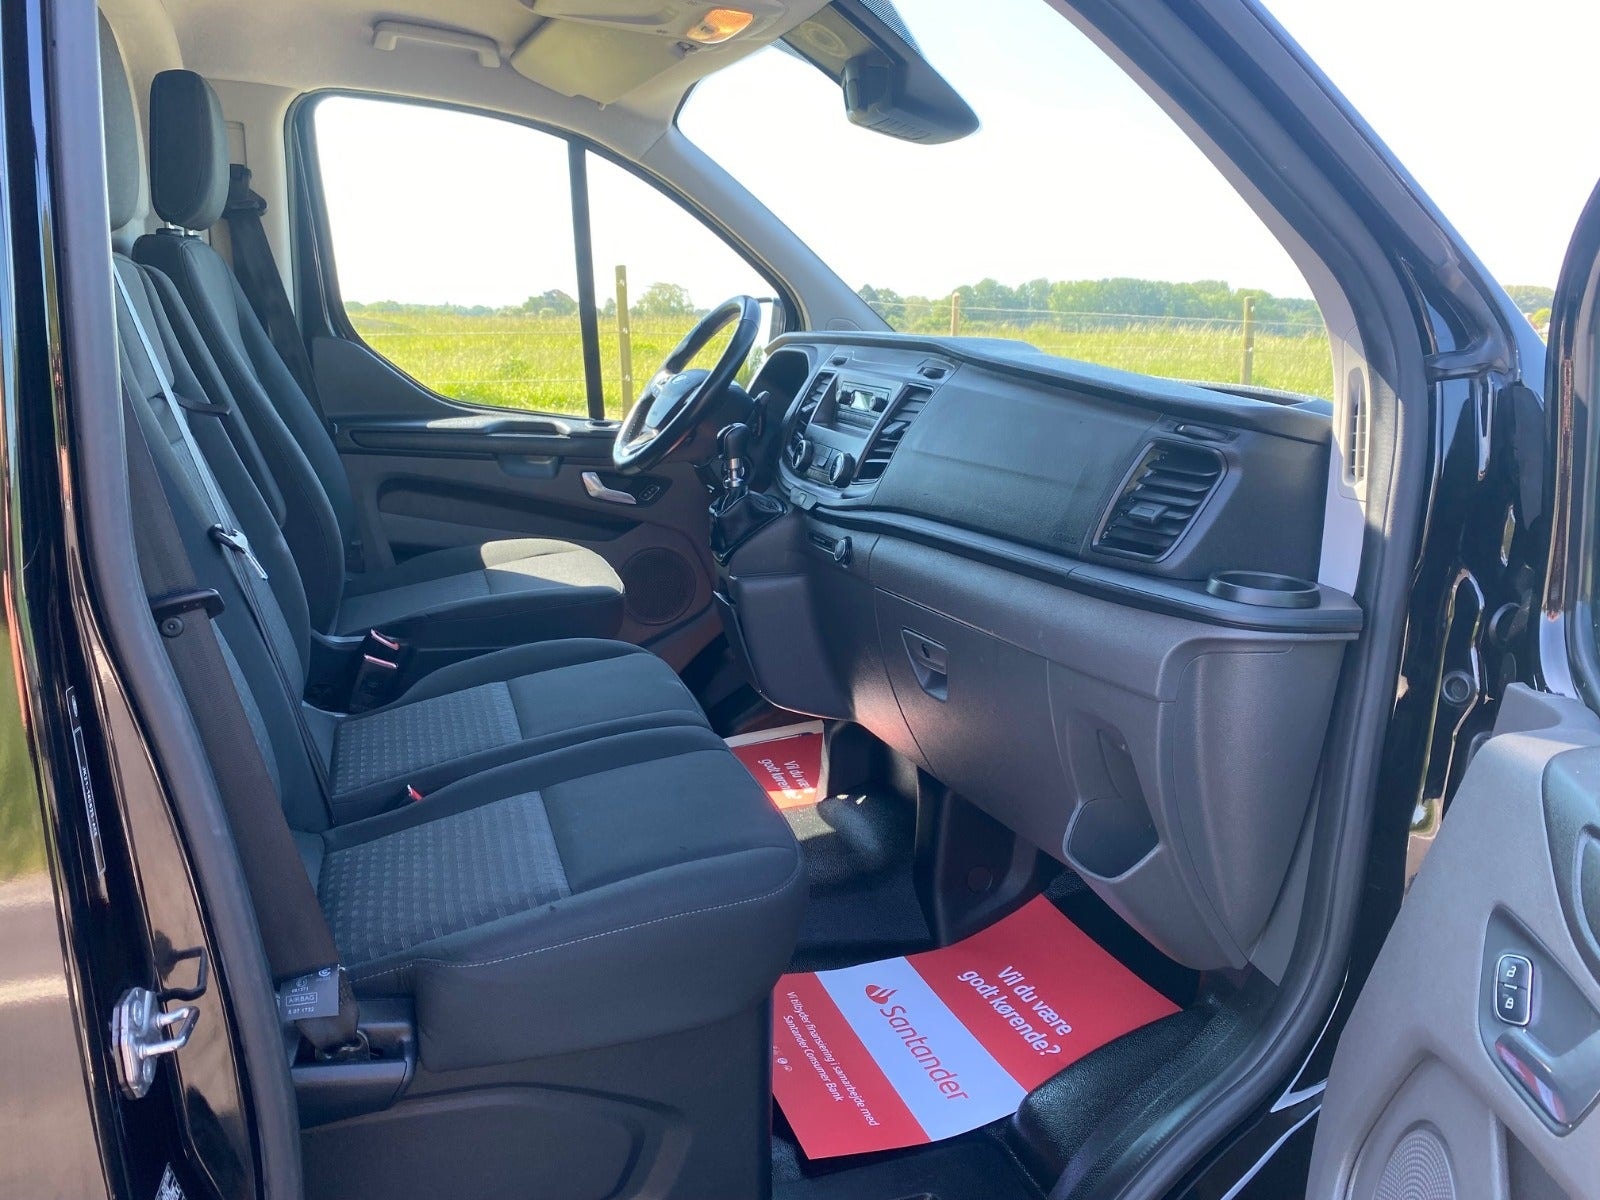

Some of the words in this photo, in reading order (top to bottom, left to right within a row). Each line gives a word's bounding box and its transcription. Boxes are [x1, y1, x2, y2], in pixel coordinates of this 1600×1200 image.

[288, 995, 314, 1004] AIRBAG
[786, 991, 798, 1000] Vi
[790, 998, 811, 1025] tilbyder
[957, 970, 1000, 1000] godt
[989, 995, 1061, 1056] kørende?
[998, 965, 1025, 986] Vil
[1013, 985, 1038, 1003] du
[1032, 1000, 1072, 1036] være
[783, 1015, 809, 1049] Santander
[804, 1048, 831, 1083] Consumer
[825, 1082, 845, 1102] Bank
[805, 1023, 836, 1064] finansiering
[880, 1005, 969, 1100] Santander
[833, 1065, 865, 1109] samarbejde
[860, 1107, 880, 1127] med
